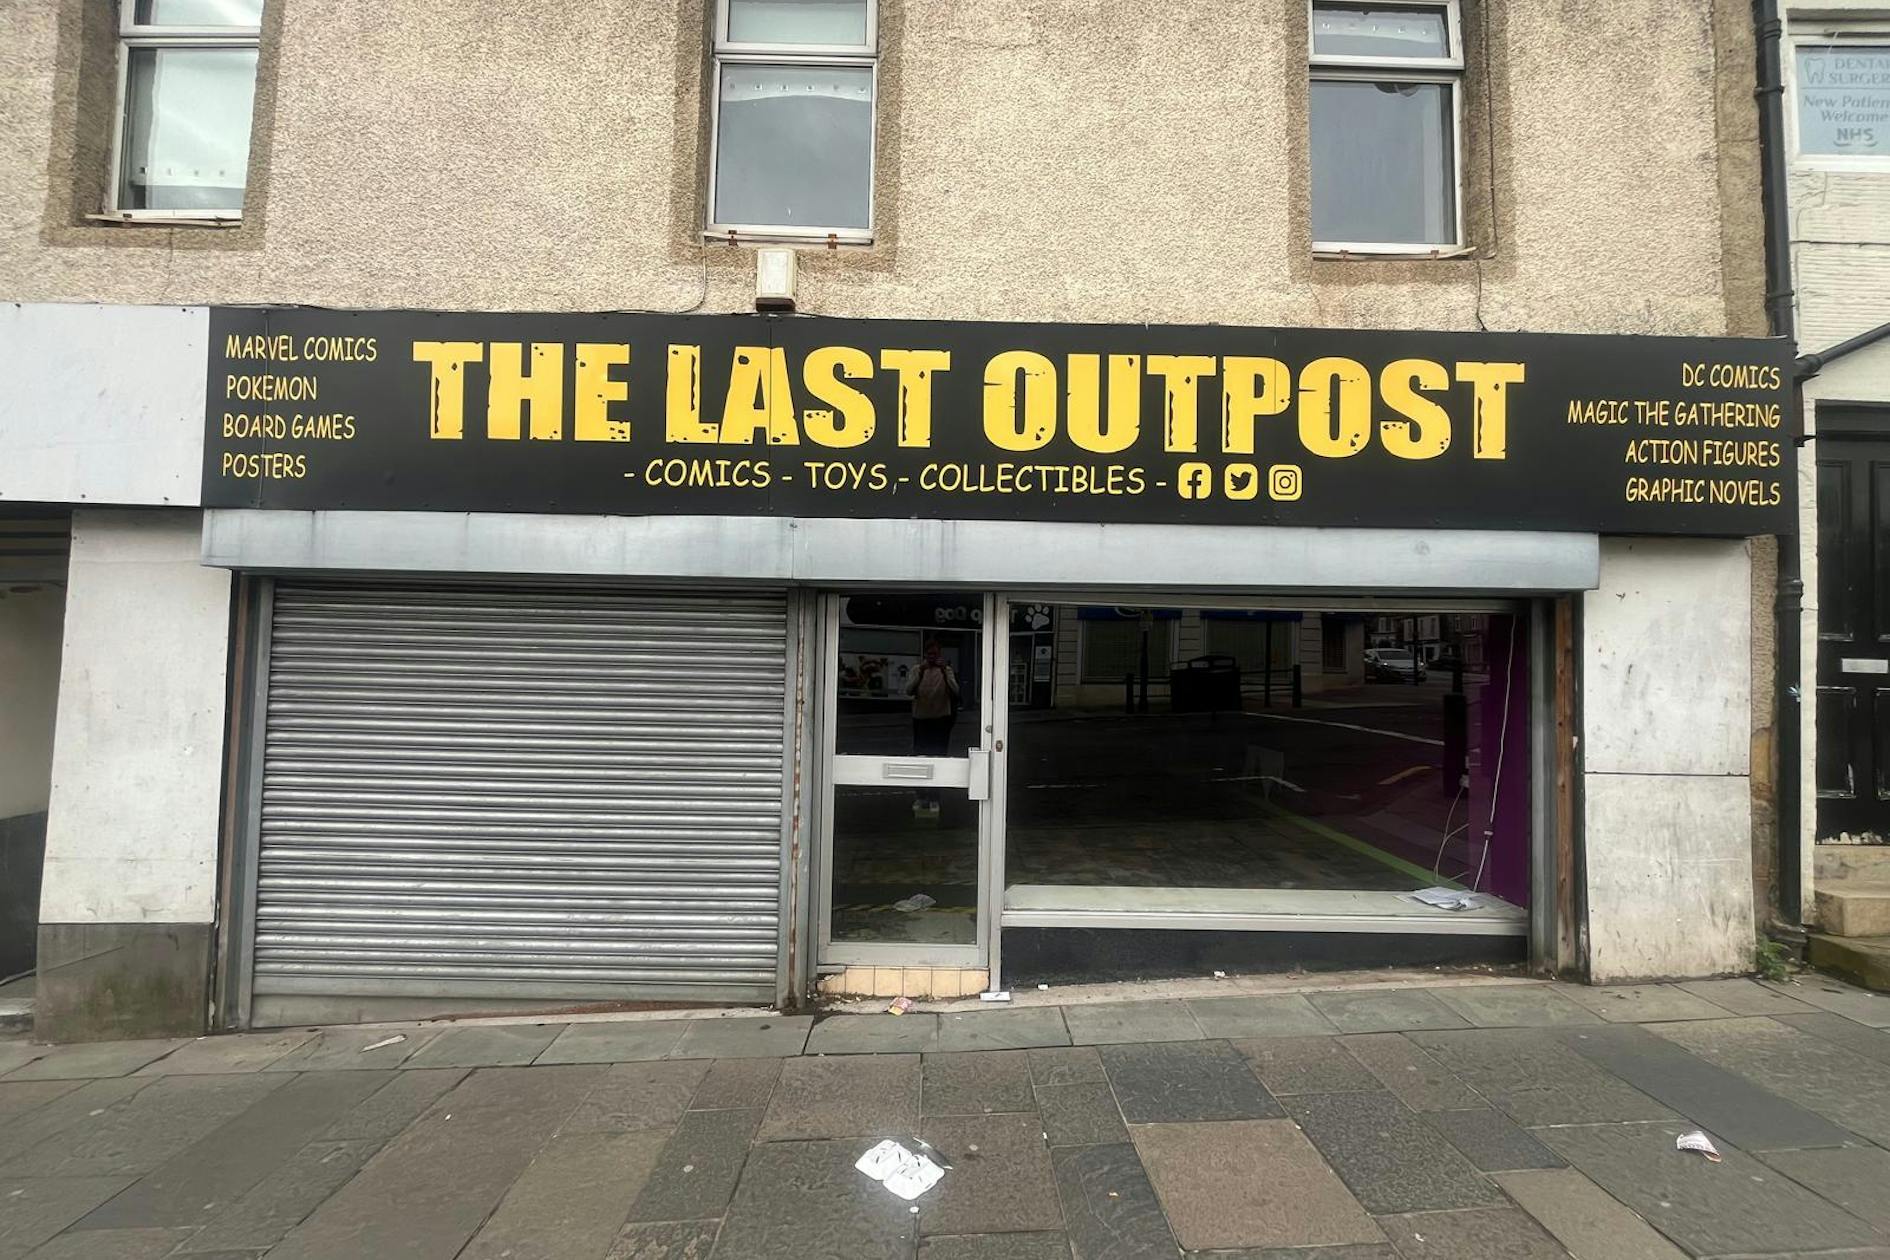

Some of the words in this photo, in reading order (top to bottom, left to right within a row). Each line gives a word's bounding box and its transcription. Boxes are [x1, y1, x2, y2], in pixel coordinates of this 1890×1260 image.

[1804, 95, 1837, 108] New
[1821, 110, 1890, 123] Welcome
[1836, 127, 1875, 142] NHS
[225, 334, 299, 362] MARVEL
[303, 336, 378, 362] COMICS
[226, 374, 317, 402] POKEMON
[1682, 363, 1705, 388] DC
[1709, 364, 1781, 390] COMICS
[412, 341, 632, 443] THE
[664, 343, 952, 449] LAST
[982, 349, 1526, 460] OUTPOST
[1567, 400, 1629, 425] MAGIC
[1634, 401, 1670, 426] THE
[1674, 401, 1781, 428] GATHERING
[223, 413, 288, 440] BOARD
[291, 414, 356, 440] GAMES
[222, 453, 307, 479] POSTERS
[1624, 439, 1698, 465] ACTION
[1702, 440, 1780, 467] FIGURES
[644, 459, 772, 489] COMICS
[803, 461, 888, 491] TOYS
[919, 462, 1146, 496] COLLECTIBLES
[1625, 477, 1705, 503] GRAPHIC
[1709, 479, 1781, 506] NOVELS
